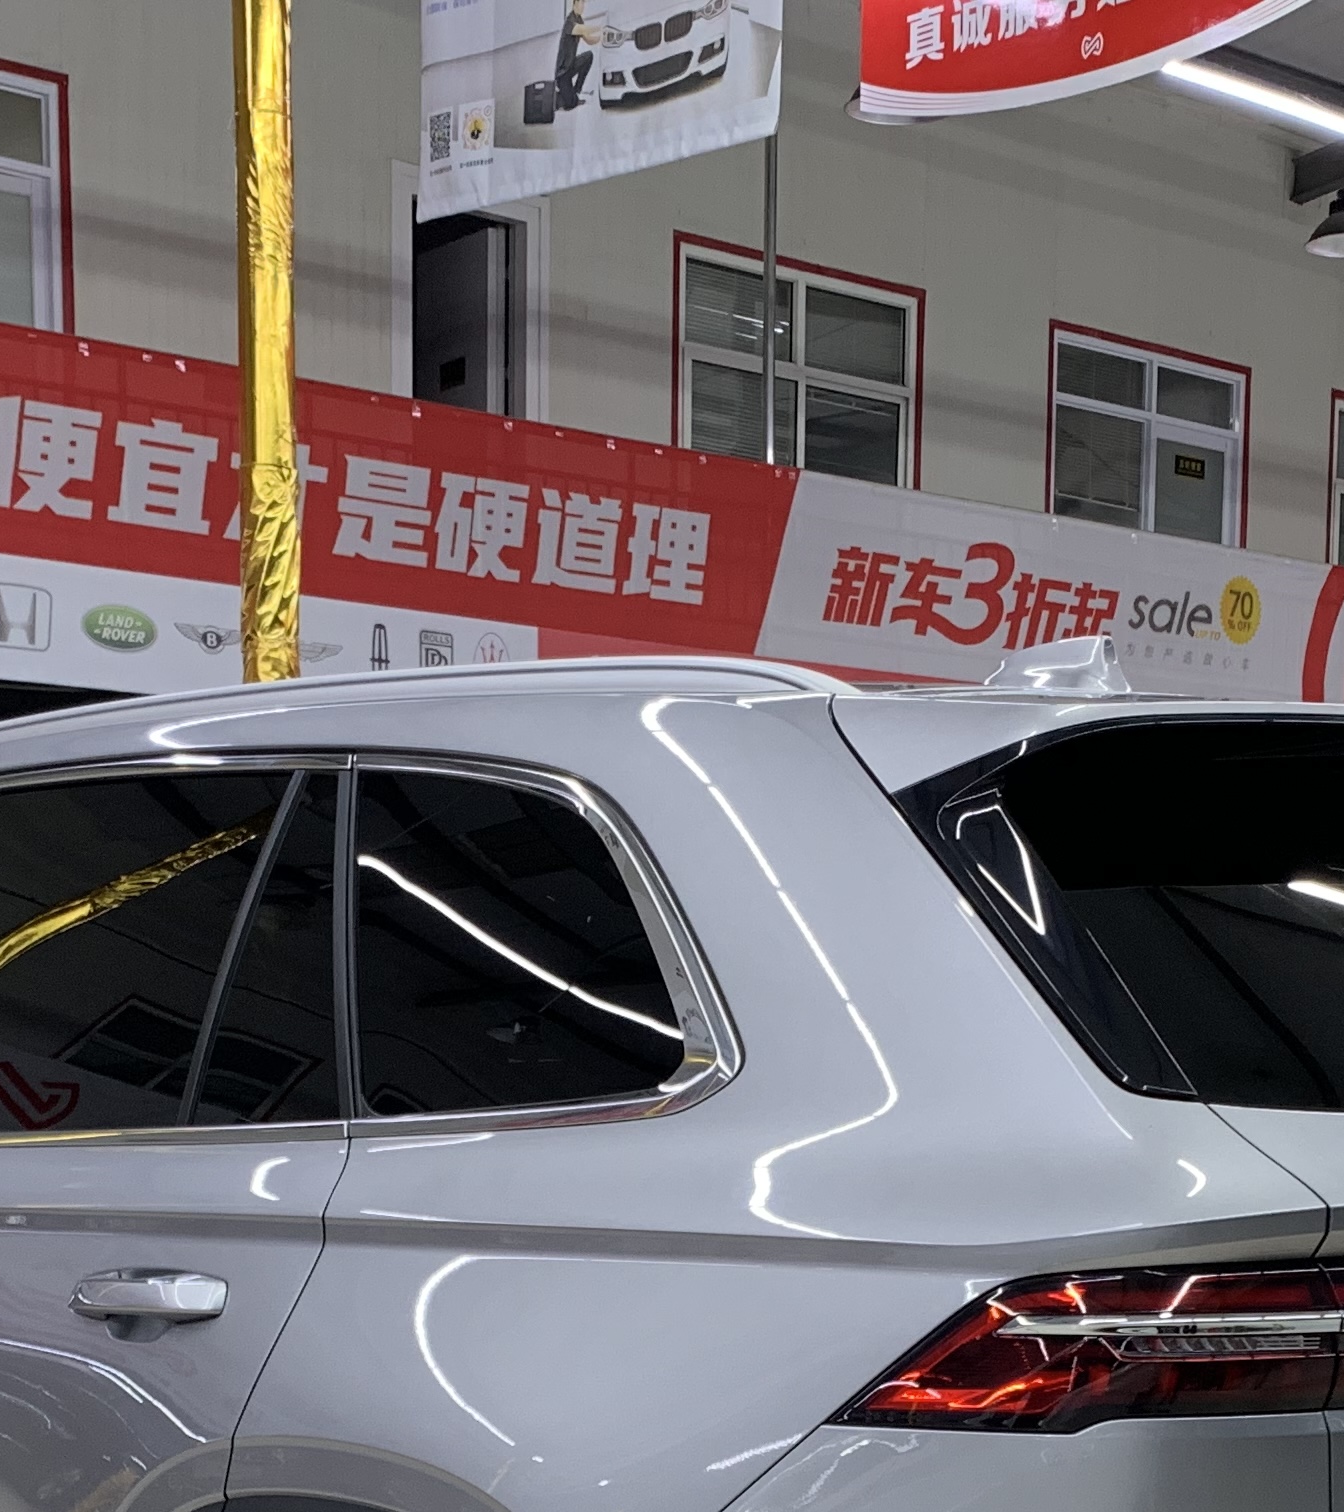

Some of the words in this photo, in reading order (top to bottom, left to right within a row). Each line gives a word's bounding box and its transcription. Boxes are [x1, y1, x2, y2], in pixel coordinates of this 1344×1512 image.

[822, 541, 1120, 651] 新车3折起
[1128, 591, 1213, 637] sale
[1229, 589, 1254, 621] 70
[422, 632, 452, 646] ROLLS
